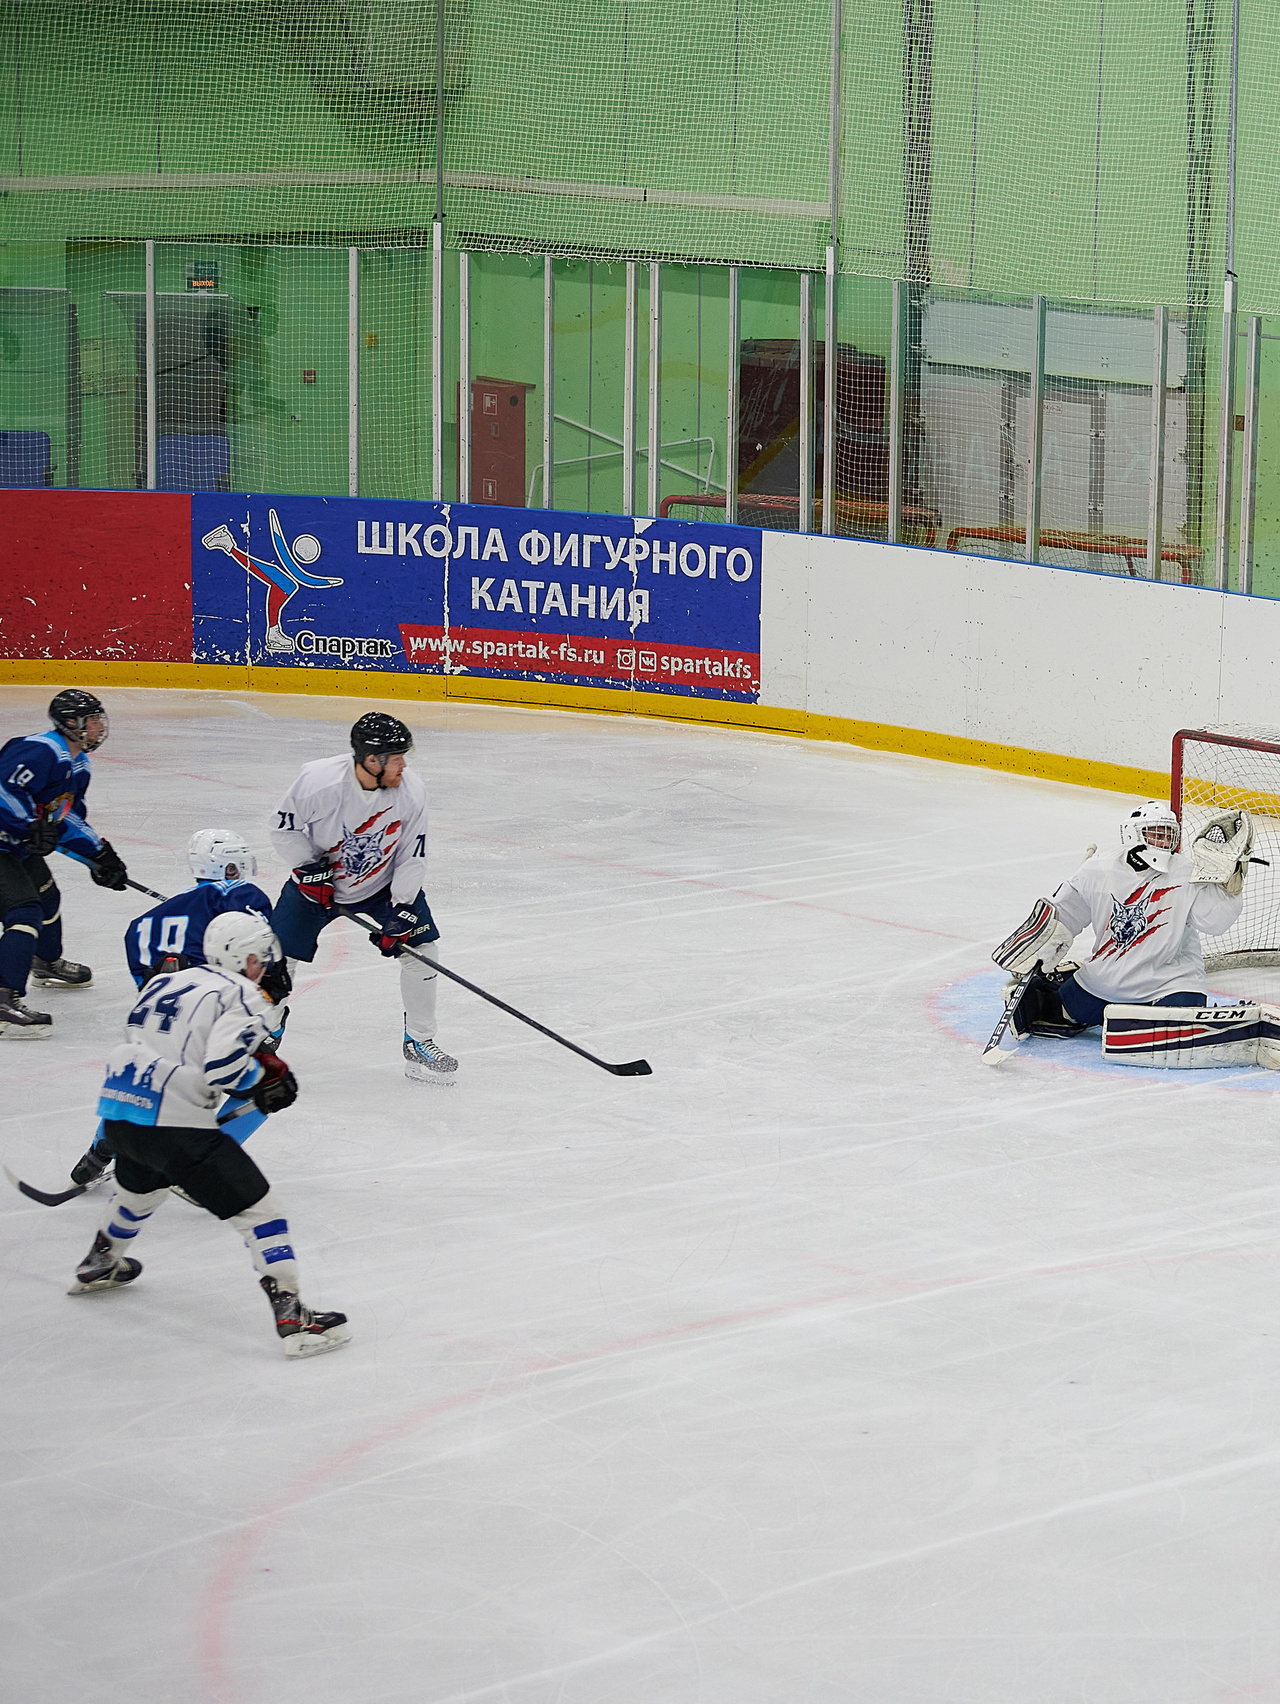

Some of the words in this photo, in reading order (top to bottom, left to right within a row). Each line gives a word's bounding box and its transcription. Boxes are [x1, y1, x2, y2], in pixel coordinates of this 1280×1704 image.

[192, 279, 214, 287] ВЫХОД
[357, 520, 509, 562] ШКОЛА
[518, 529, 754, 582] ФИГУРНОГО
[471, 576, 650, 623] КАТАНИЯ
[295, 630, 392, 660] Спартак
[409, 637, 605, 664] www.spartak-fs.ru
[660, 655, 752, 679] spartakfs
[277, 811, 295, 831] 71
[126, 976, 201, 1035] 24
[1195, 1009, 1247, 1020] CCM
